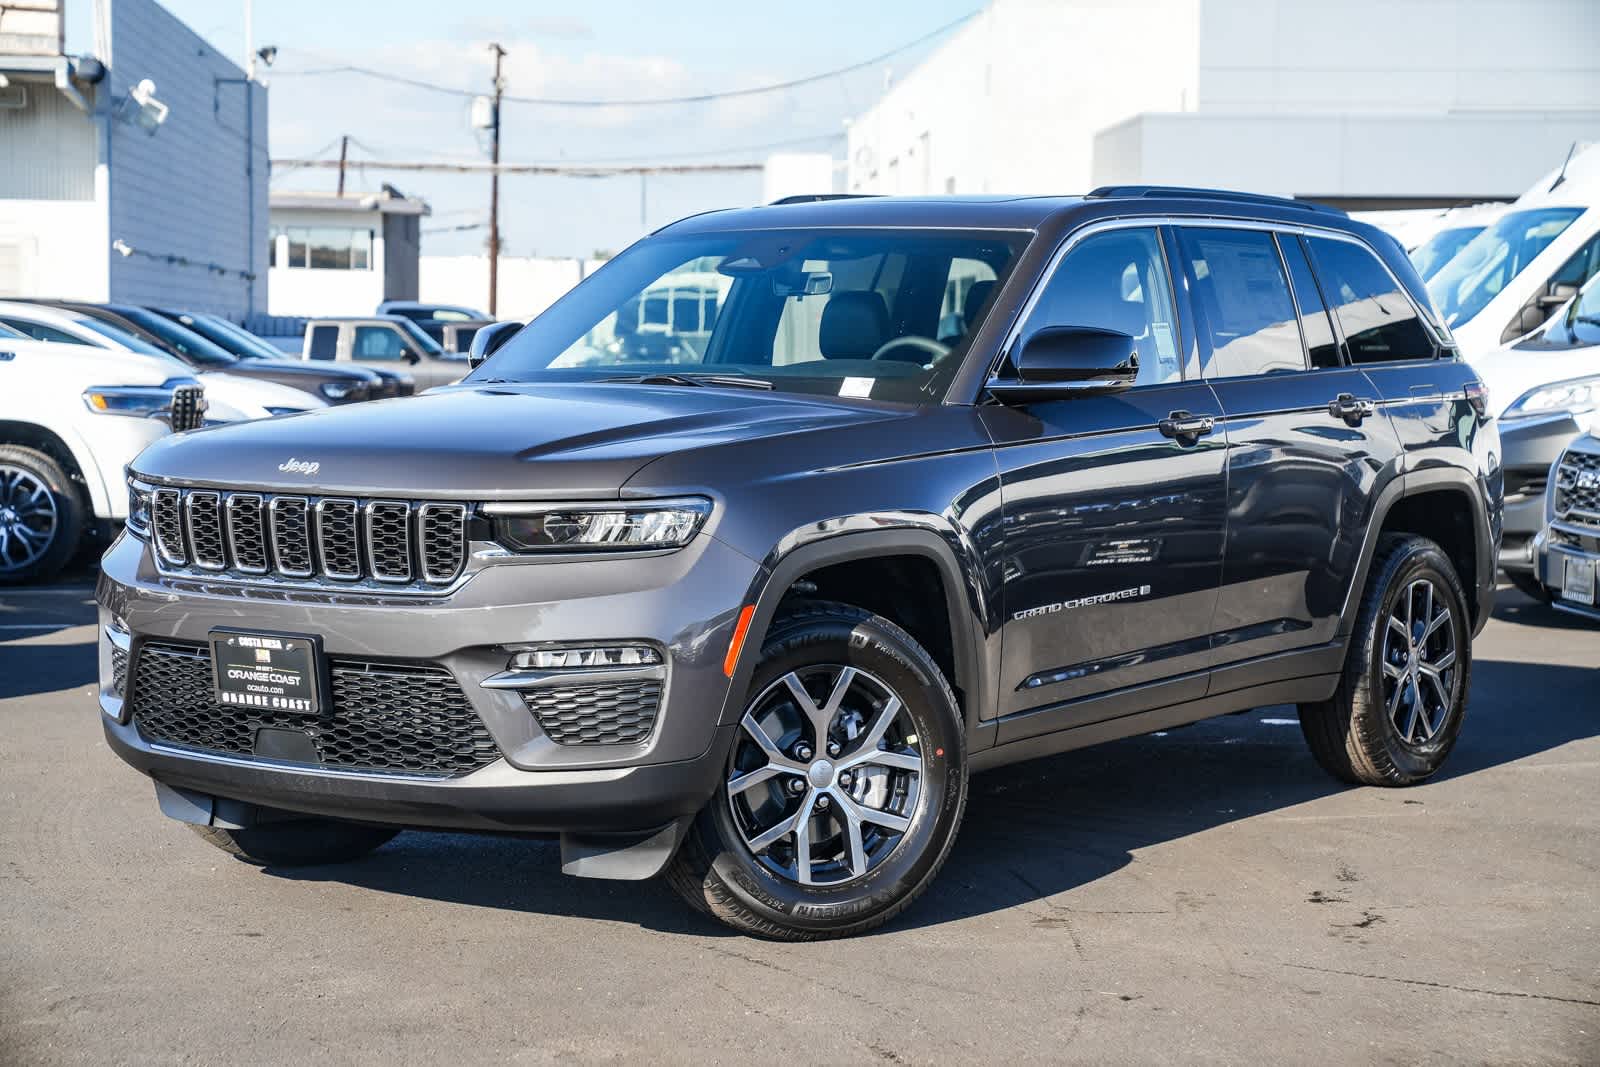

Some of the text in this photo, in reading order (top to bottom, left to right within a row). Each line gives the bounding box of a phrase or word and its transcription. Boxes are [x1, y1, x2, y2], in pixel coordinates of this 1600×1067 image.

[278, 457, 320, 475] Jeep
[1013, 587, 1138, 621] GRAND CHEROKEE
[227, 669, 301, 686] ORANGE COAST
[247, 684, 284, 695] ocauto.com
[222, 692, 311, 711] ORANGE COAST
